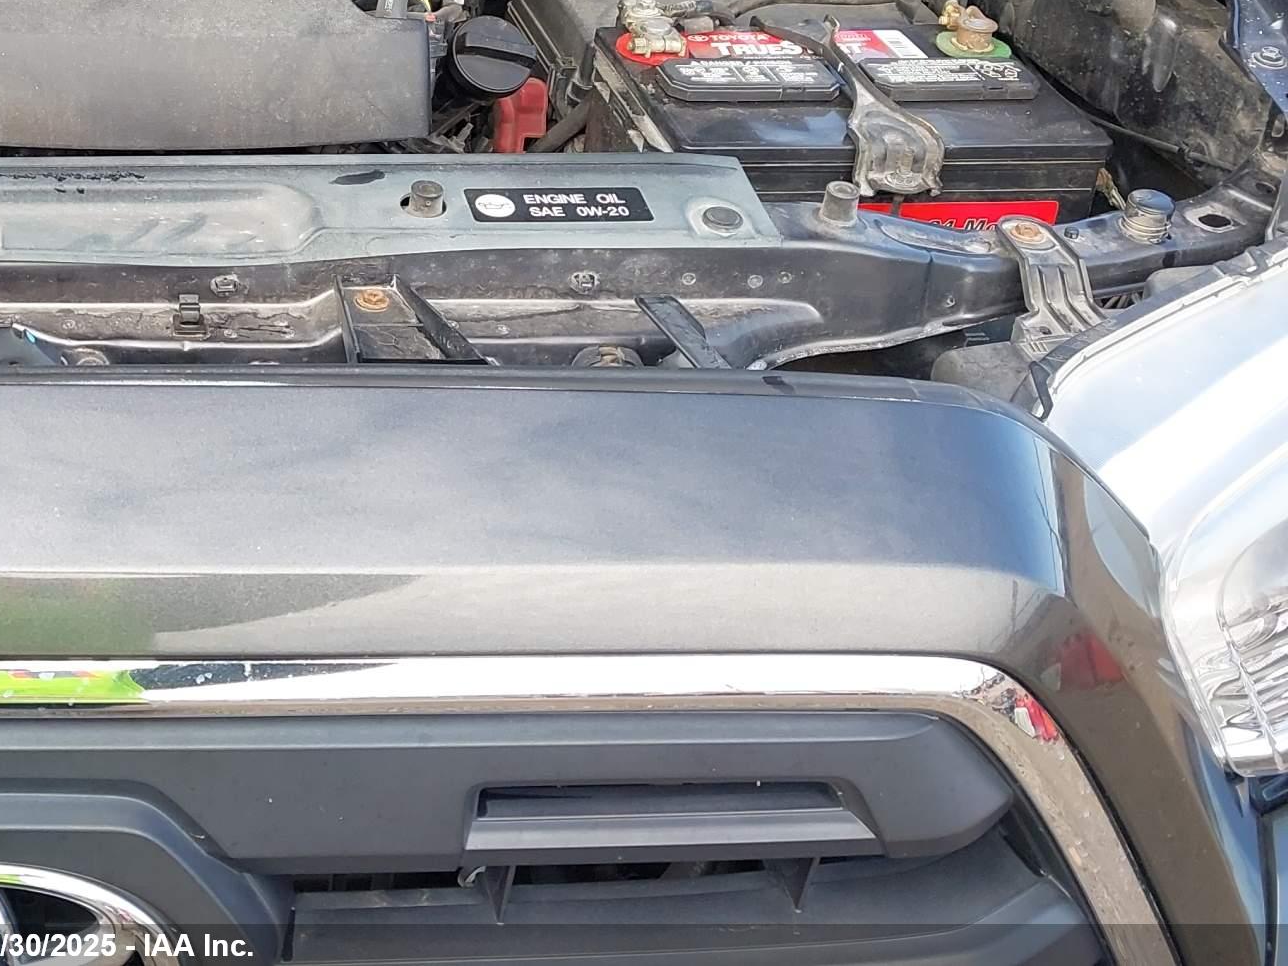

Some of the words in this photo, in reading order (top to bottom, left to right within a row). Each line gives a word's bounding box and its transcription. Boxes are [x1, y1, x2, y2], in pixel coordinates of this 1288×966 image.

[709, 33, 769, 42] TOYOTA
[523, 193, 587, 205] ENGINE
[596, 193, 626, 205] OIL
[529, 206, 566, 218] SAE
[576, 206, 630, 218] 0W-20
